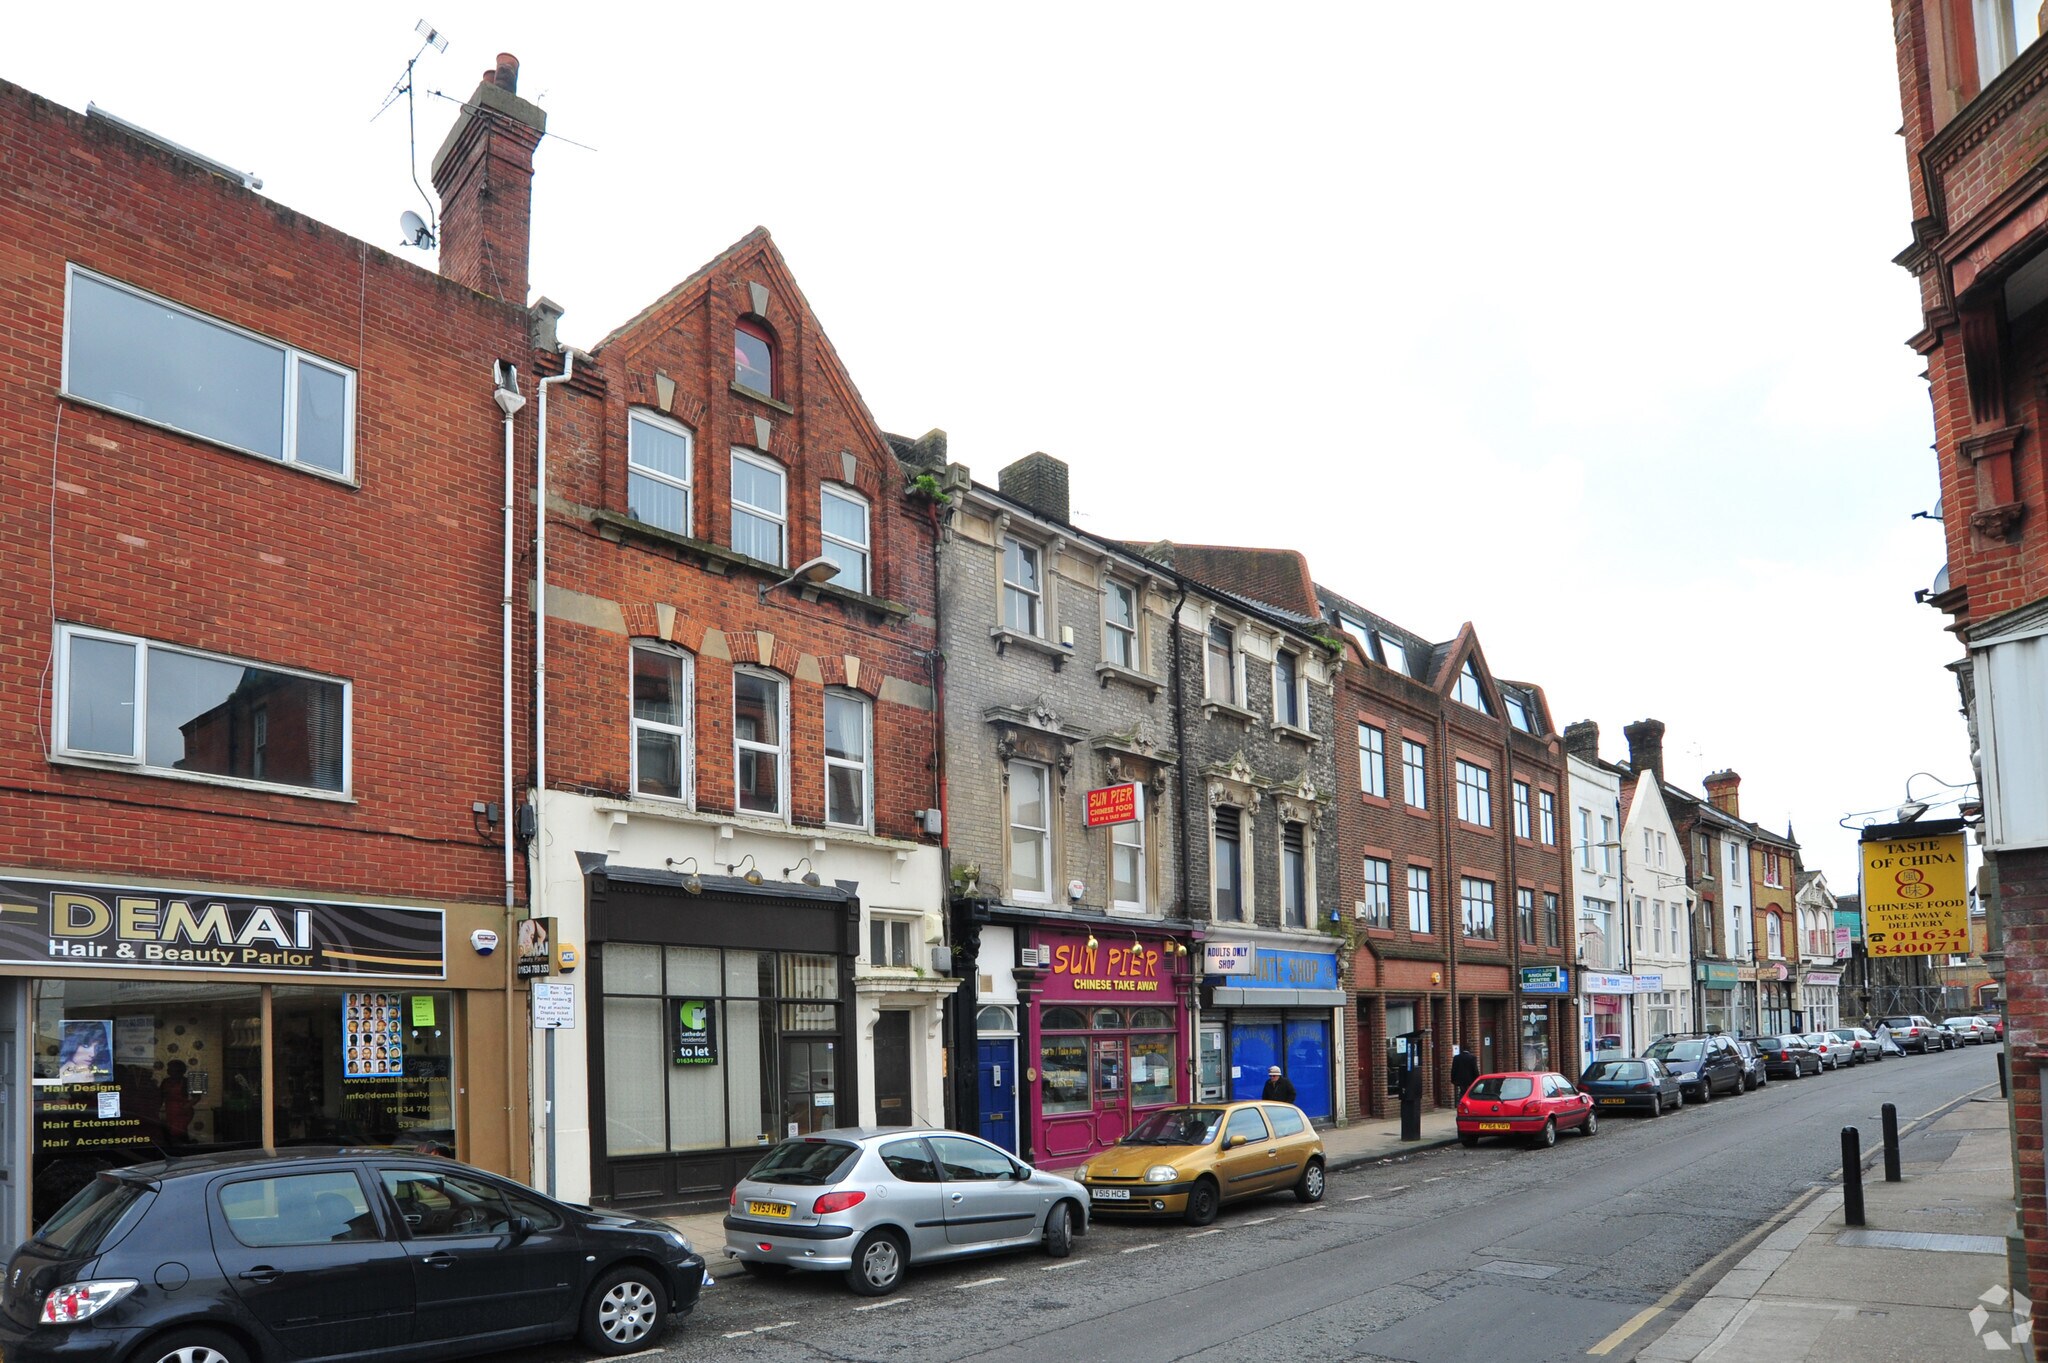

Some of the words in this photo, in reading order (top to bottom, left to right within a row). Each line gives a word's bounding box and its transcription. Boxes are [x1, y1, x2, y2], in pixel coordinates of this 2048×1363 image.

[1090, 792, 1107, 807] SUN
[1110, 787, 1132, 804] PIER
[1090, 806, 1114, 816] CHINESE
[1115, 803, 1133, 812] FOOD
[1885, 840, 1940, 854] TASTE
[1871, 858, 1894, 869] OF
[1899, 853, 1956, 867] CHINA
[1868, 901, 1923, 912] CHINESE
[1927, 899, 1964, 908] FOOD
[50, 891, 313, 950] DEMAI
[1912, 911, 1941, 919] AWAY
[1888, 920, 1945, 929] DELIVERY
[1893, 928, 1967, 941] 01634
[49, 939, 107, 957] Hair
[116, 943, 136, 959] &
[145, 943, 235, 966] Beauty
[242, 948, 313, 966] Parlor
[1207, 947, 1231, 957] ADULTS
[1232, 947, 1248, 957] ONLY
[1875, 941, 1960, 954] 840071
[1054, 945, 1098, 975] SUN
[1107, 948, 1158, 976] PIER
[1218, 960, 1235, 969] SHOP
[541, 964, 549, 973] 353
[1289, 958, 1318, 983] SHOP
[1074, 979, 1112, 990] CHINESE
[1113, 980, 1135, 991] TAKE
[1137, 981, 1158, 991] AWAY
[681, 1047, 693, 1057] to
[695, 1046, 709, 1057] let
[43, 1084, 69, 1093] Hair
[73, 1084, 122, 1093] Designs
[43, 1102, 87, 1111] Beauty
[387, 1106, 414, 1114] 01634
[43, 1121, 69, 1129] Hair
[73, 1119, 140, 1128] Extensions
[43, 1139, 69, 1148] Hair
[76, 1135, 151, 1146] Accessories
[1095, 1190, 1110, 1198] V515
[1111, 1190, 1127, 1198] HCE
[753, 1202, 771, 1213] SV53
[771, 1203, 787, 1215] HWB
